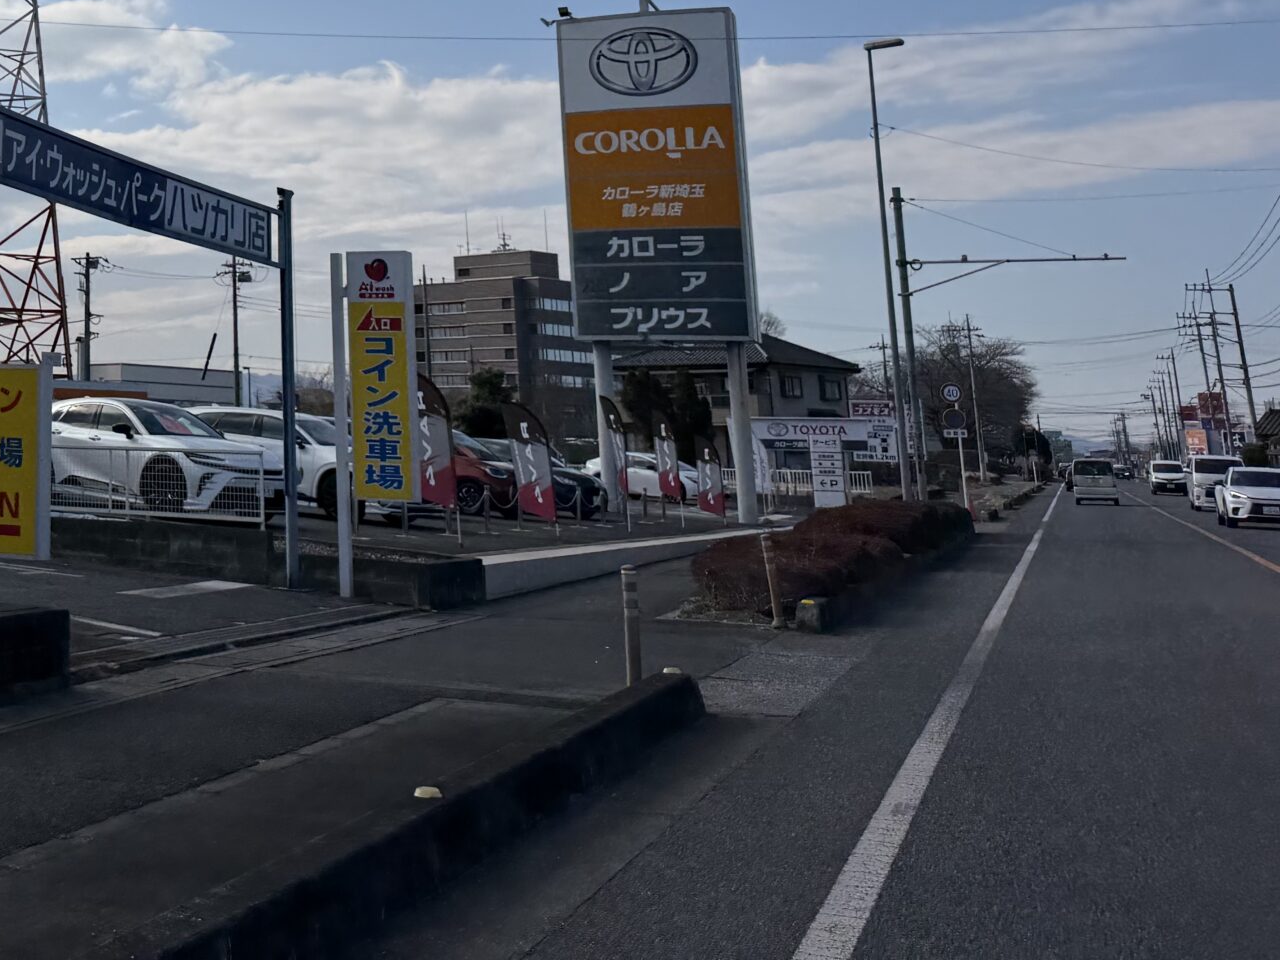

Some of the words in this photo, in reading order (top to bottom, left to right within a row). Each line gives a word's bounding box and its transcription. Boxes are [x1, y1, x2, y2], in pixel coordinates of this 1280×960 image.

[574, 126, 726, 157] COROLLA
[602, 183, 706, 201] カローラ新埼玉
[606, 235, 706, 259] カローラ
[368, 318, 391, 331] 入口
[610, 306, 712, 331] プリウス
[946, 388, 959, 399] 40
[361, 337, 404, 490] コイン洗車場
[791, 425, 848, 436] TOYOTA
